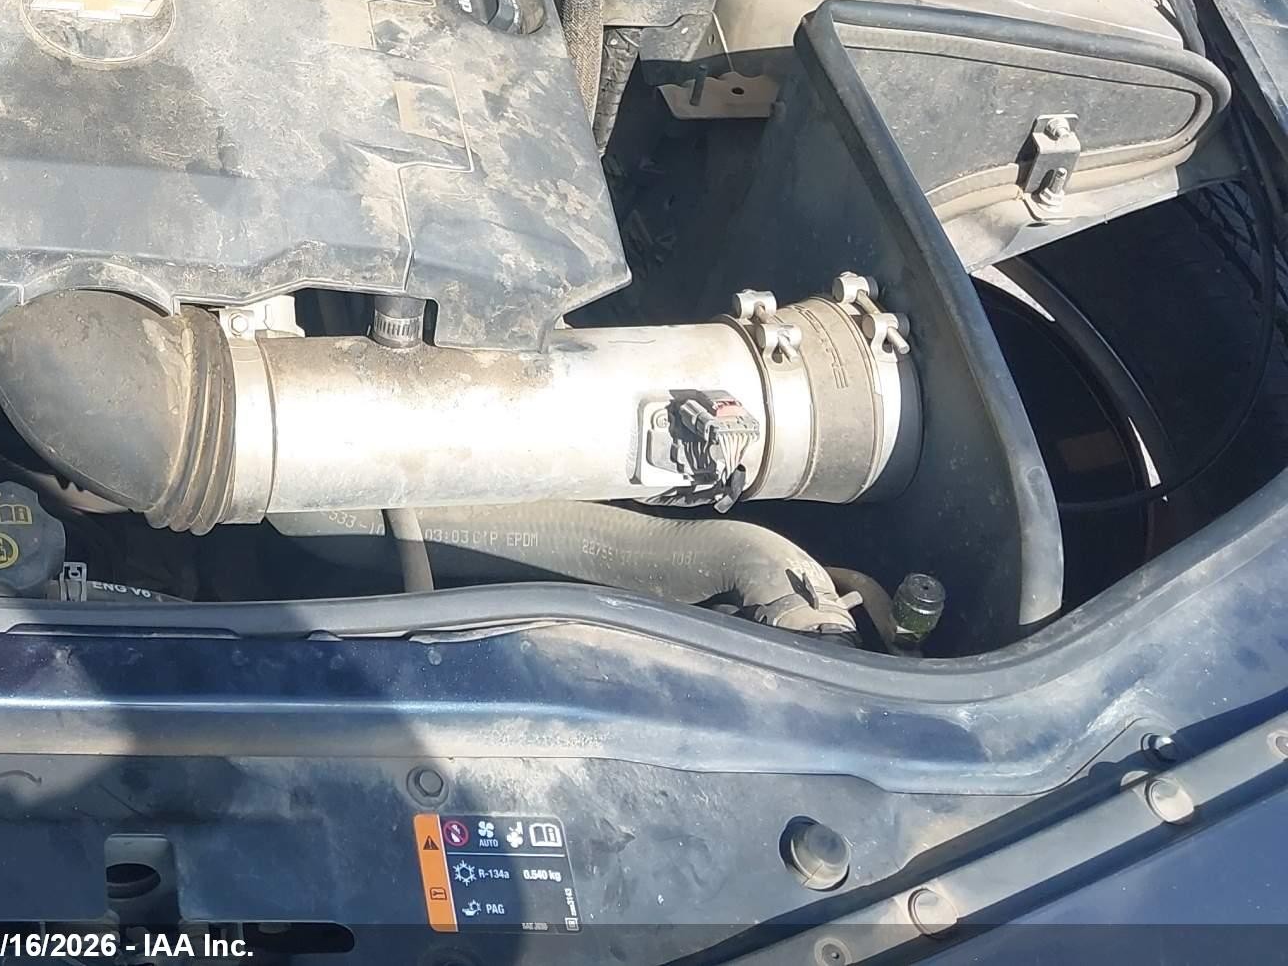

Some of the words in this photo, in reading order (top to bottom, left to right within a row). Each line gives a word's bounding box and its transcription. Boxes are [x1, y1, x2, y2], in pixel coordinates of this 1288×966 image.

[506, 531, 539, 547] EPDM
[92, 580, 128, 593] ENG
[128, 586, 152, 599] V6
[479, 838, 499, 848] AUTO
[478, 868, 510, 879] R-134a
[523, 869, 548, 881] 0.540
[548, 869, 562, 882] kg
[486, 903, 505, 915] PAG
